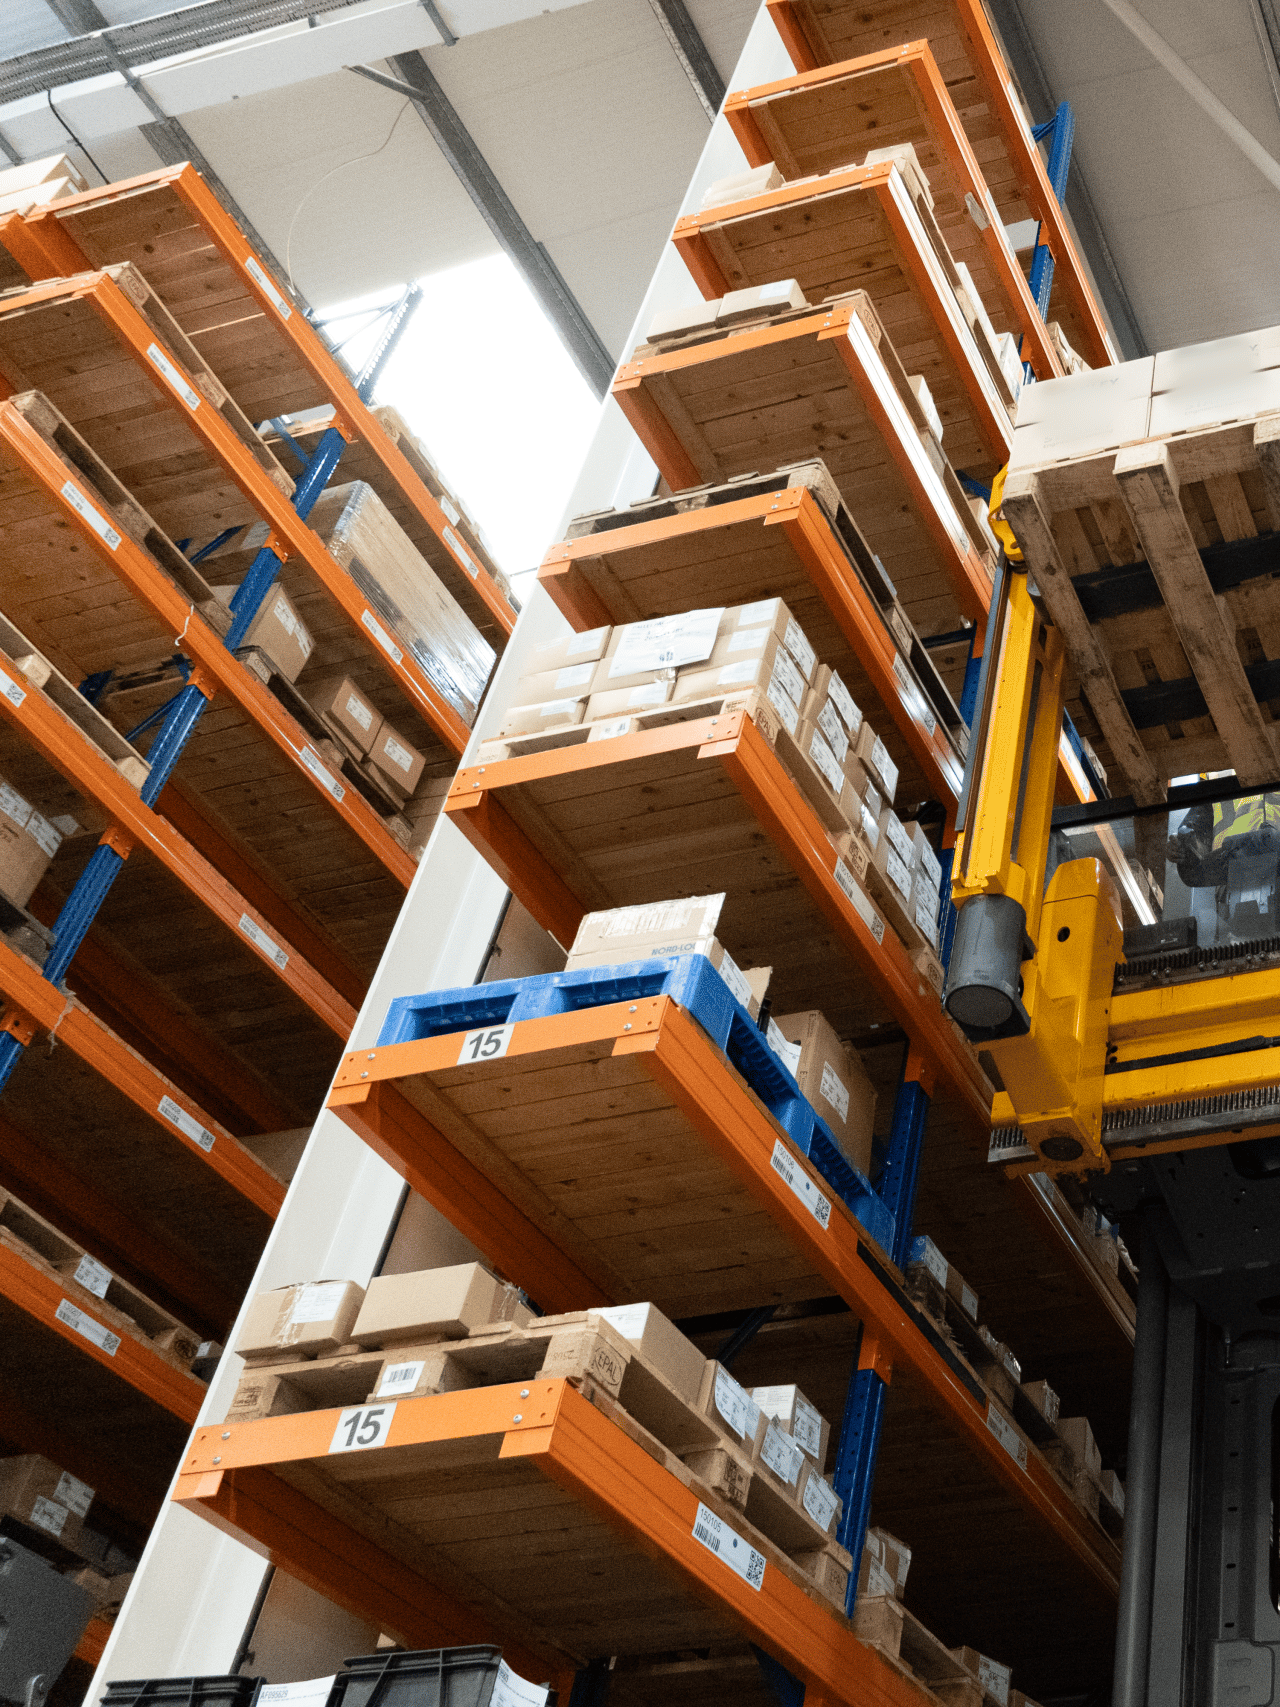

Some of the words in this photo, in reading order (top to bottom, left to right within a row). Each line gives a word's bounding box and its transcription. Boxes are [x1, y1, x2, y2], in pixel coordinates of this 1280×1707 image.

[469, 1029, 504, 1059] 15
[778, 1144, 794, 1169] 150106
[598, 1351, 617, 1382] EPAL
[344, 1408, 385, 1447] 15
[701, 1508, 721, 1533] 150105
